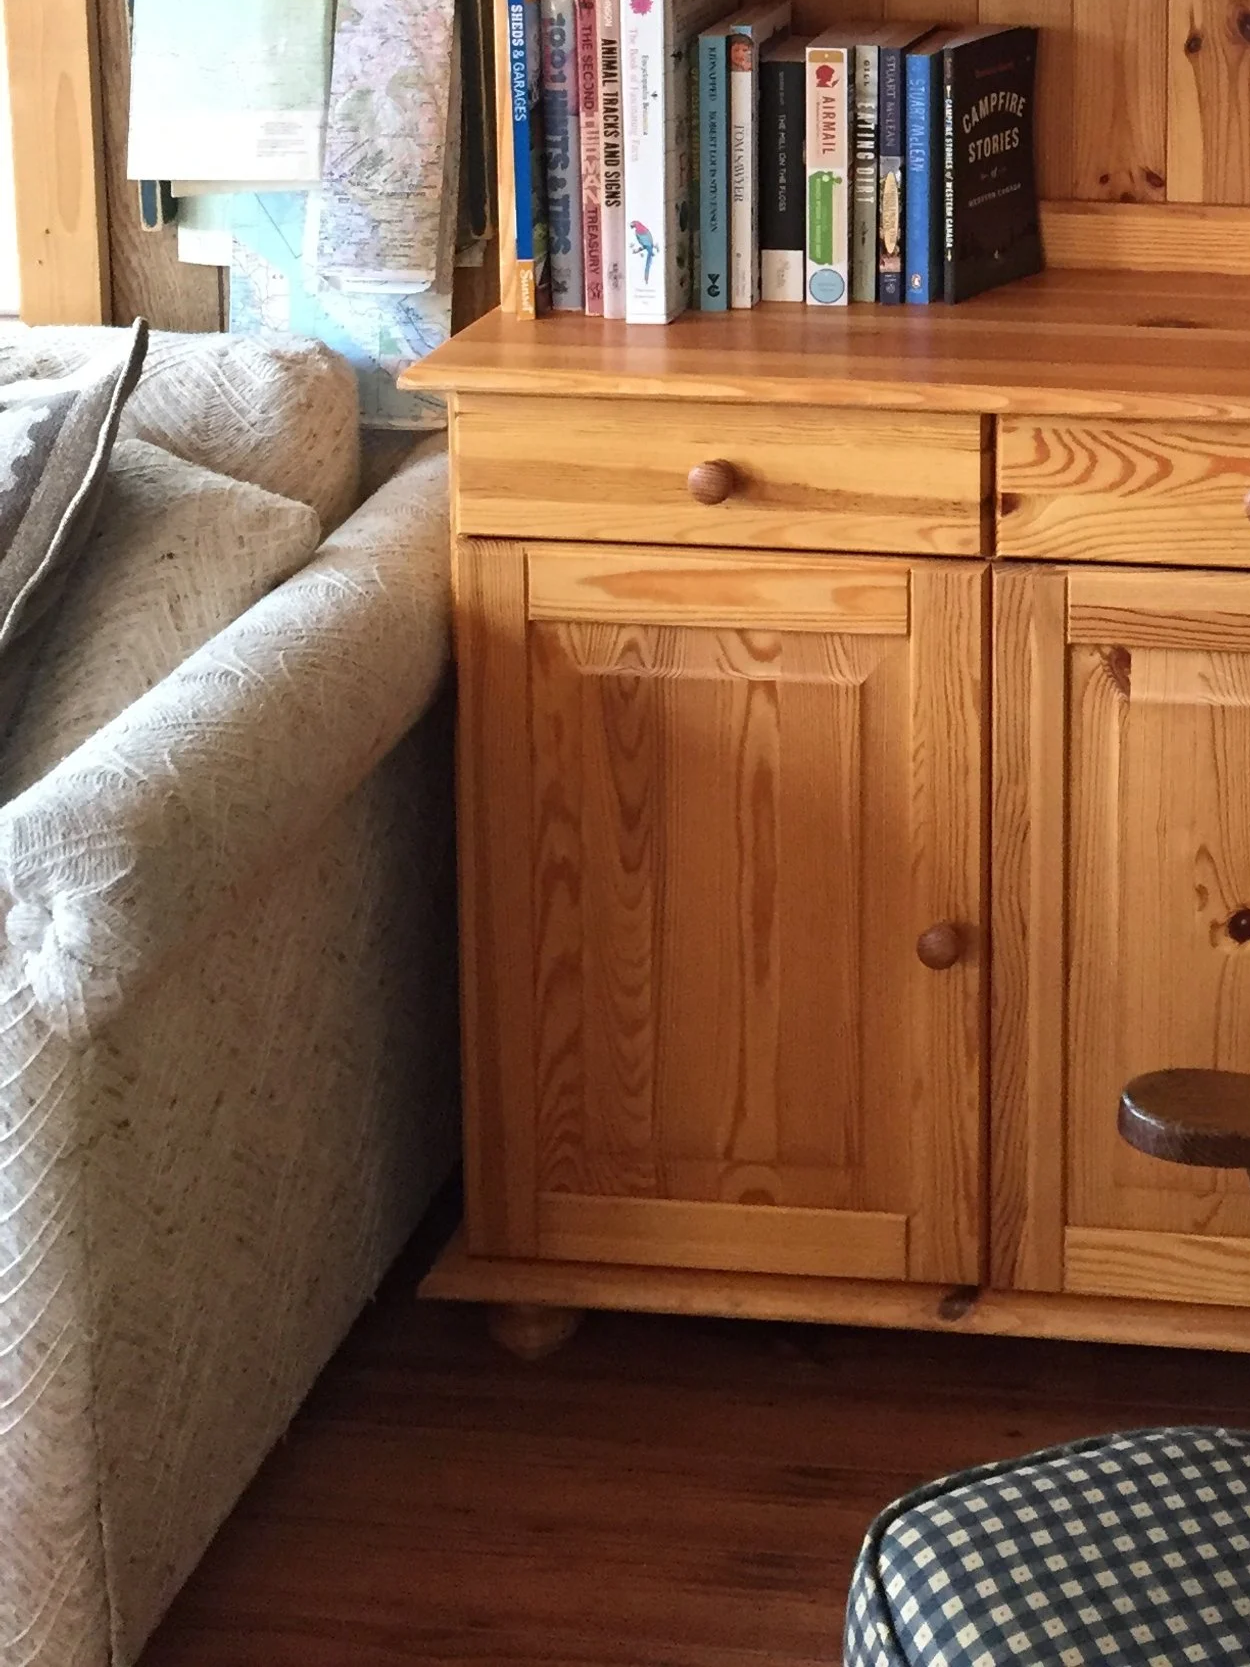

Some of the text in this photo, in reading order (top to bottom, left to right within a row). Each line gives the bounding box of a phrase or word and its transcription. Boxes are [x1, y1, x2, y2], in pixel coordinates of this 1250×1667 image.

[511, 4, 527, 122] SHEDS & GARAGES
[549, 12, 568, 84] 1001
[582, 25, 592, 49] THE
[582, 51, 595, 110] SECOND
[885, 55, 896, 98] STUART
[910, 78, 926, 120] STUART
[601, 38, 621, 207] ANIMAL TRACKS AND SIGNS
[777, 114, 786, 129] THE
[822, 96, 836, 154] AIRMAIL
[856, 60, 875, 203] GILL EATING DIRT
[962, 91, 1027, 134] CAMPFIRE
[909, 124, 926, 172] McLEAN
[968, 127, 1020, 164] STORIES
[586, 207, 601, 274] TREASURY
